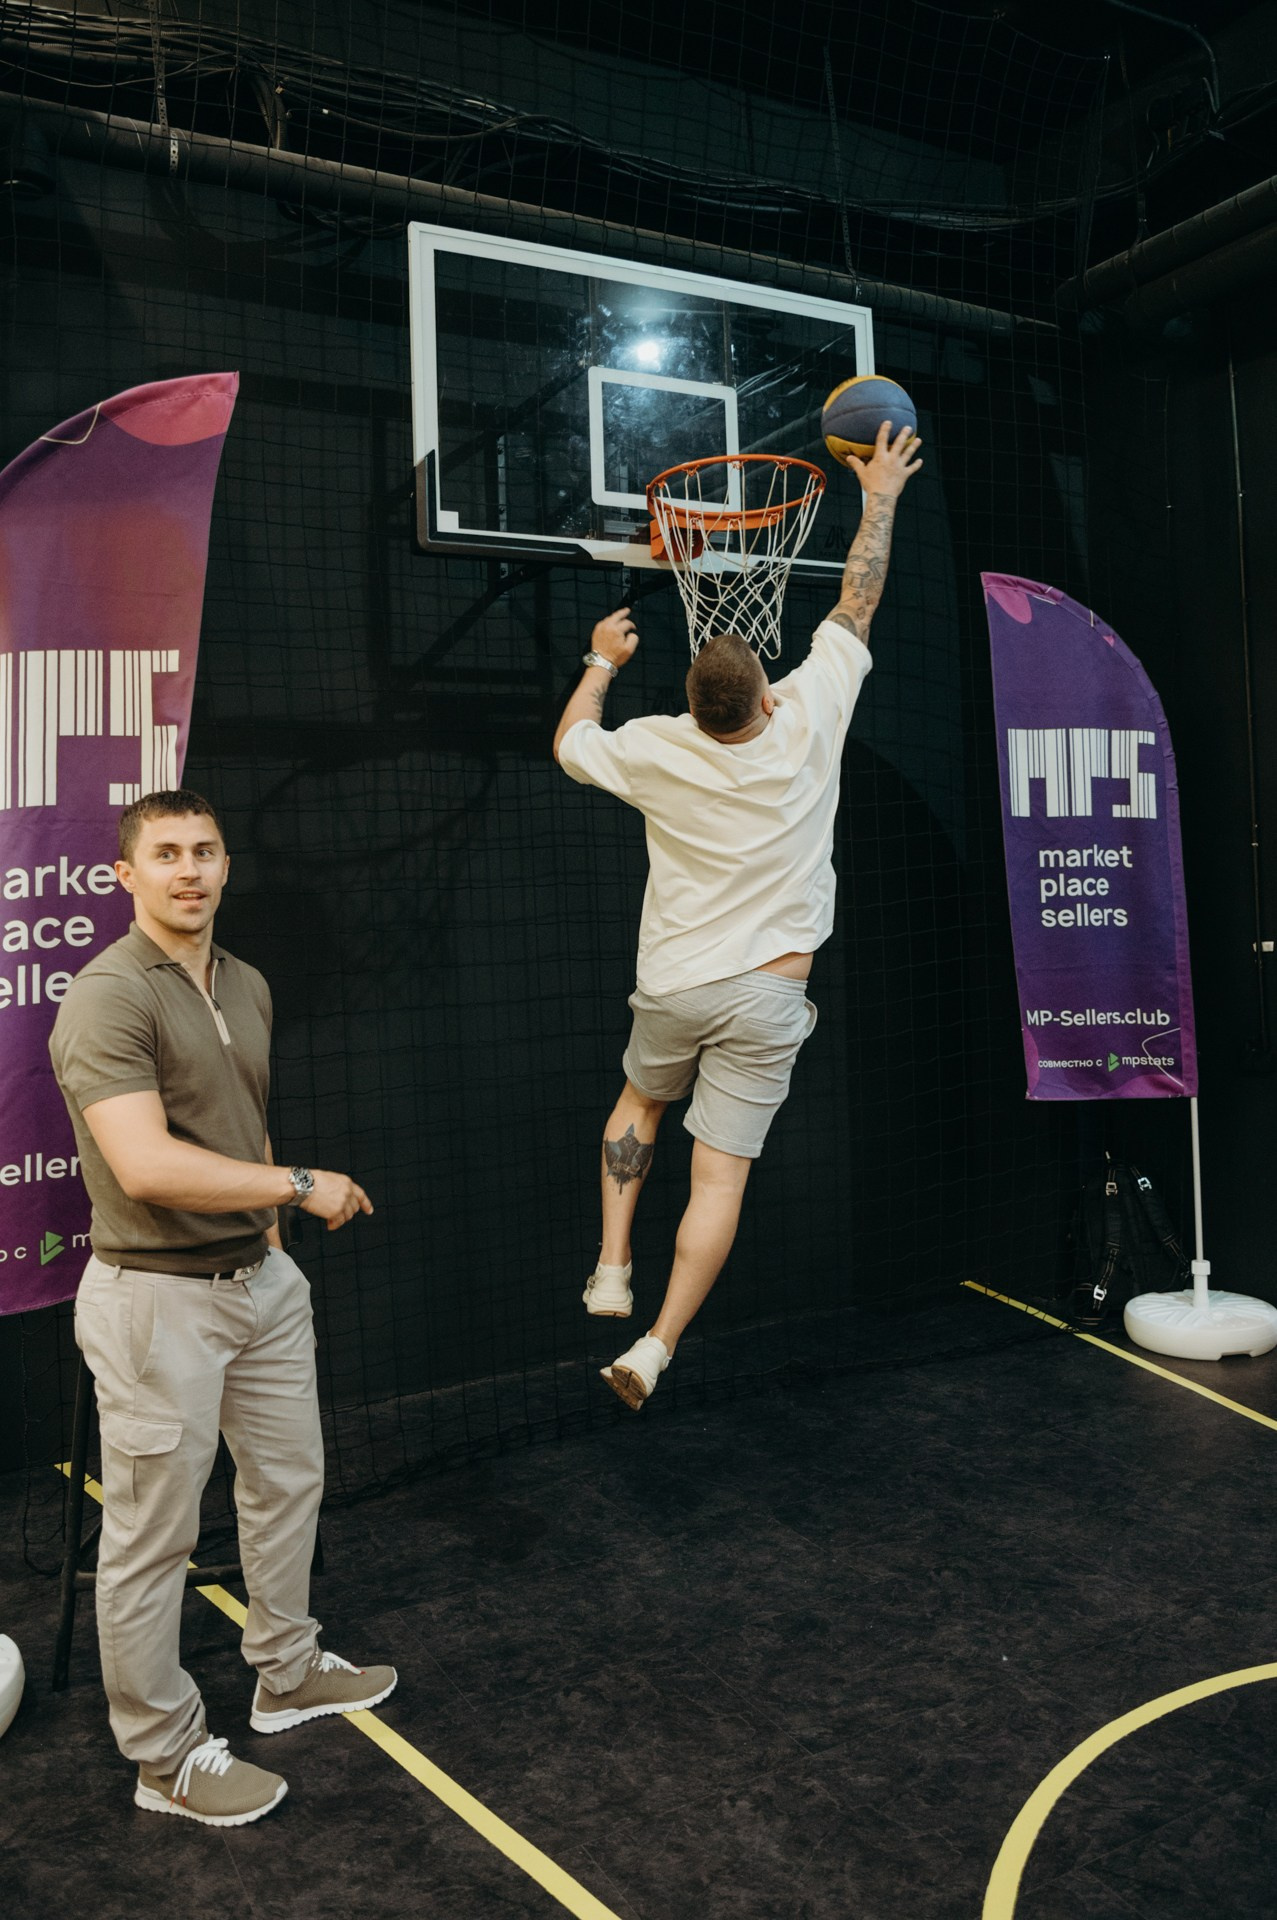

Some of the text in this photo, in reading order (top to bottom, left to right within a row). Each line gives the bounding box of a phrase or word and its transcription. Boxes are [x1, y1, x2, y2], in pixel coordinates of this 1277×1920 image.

[1039, 844, 1133, 868] market
[0, 856, 118, 900] arke
[1040, 873, 1110, 904] place
[1041, 903, 1129, 927] sellers
[2, 914, 95, 952] ace
[1026, 1008, 1171, 1026] MP-Sellers.club
[1122, 1056, 1175, 1068] mpstats
